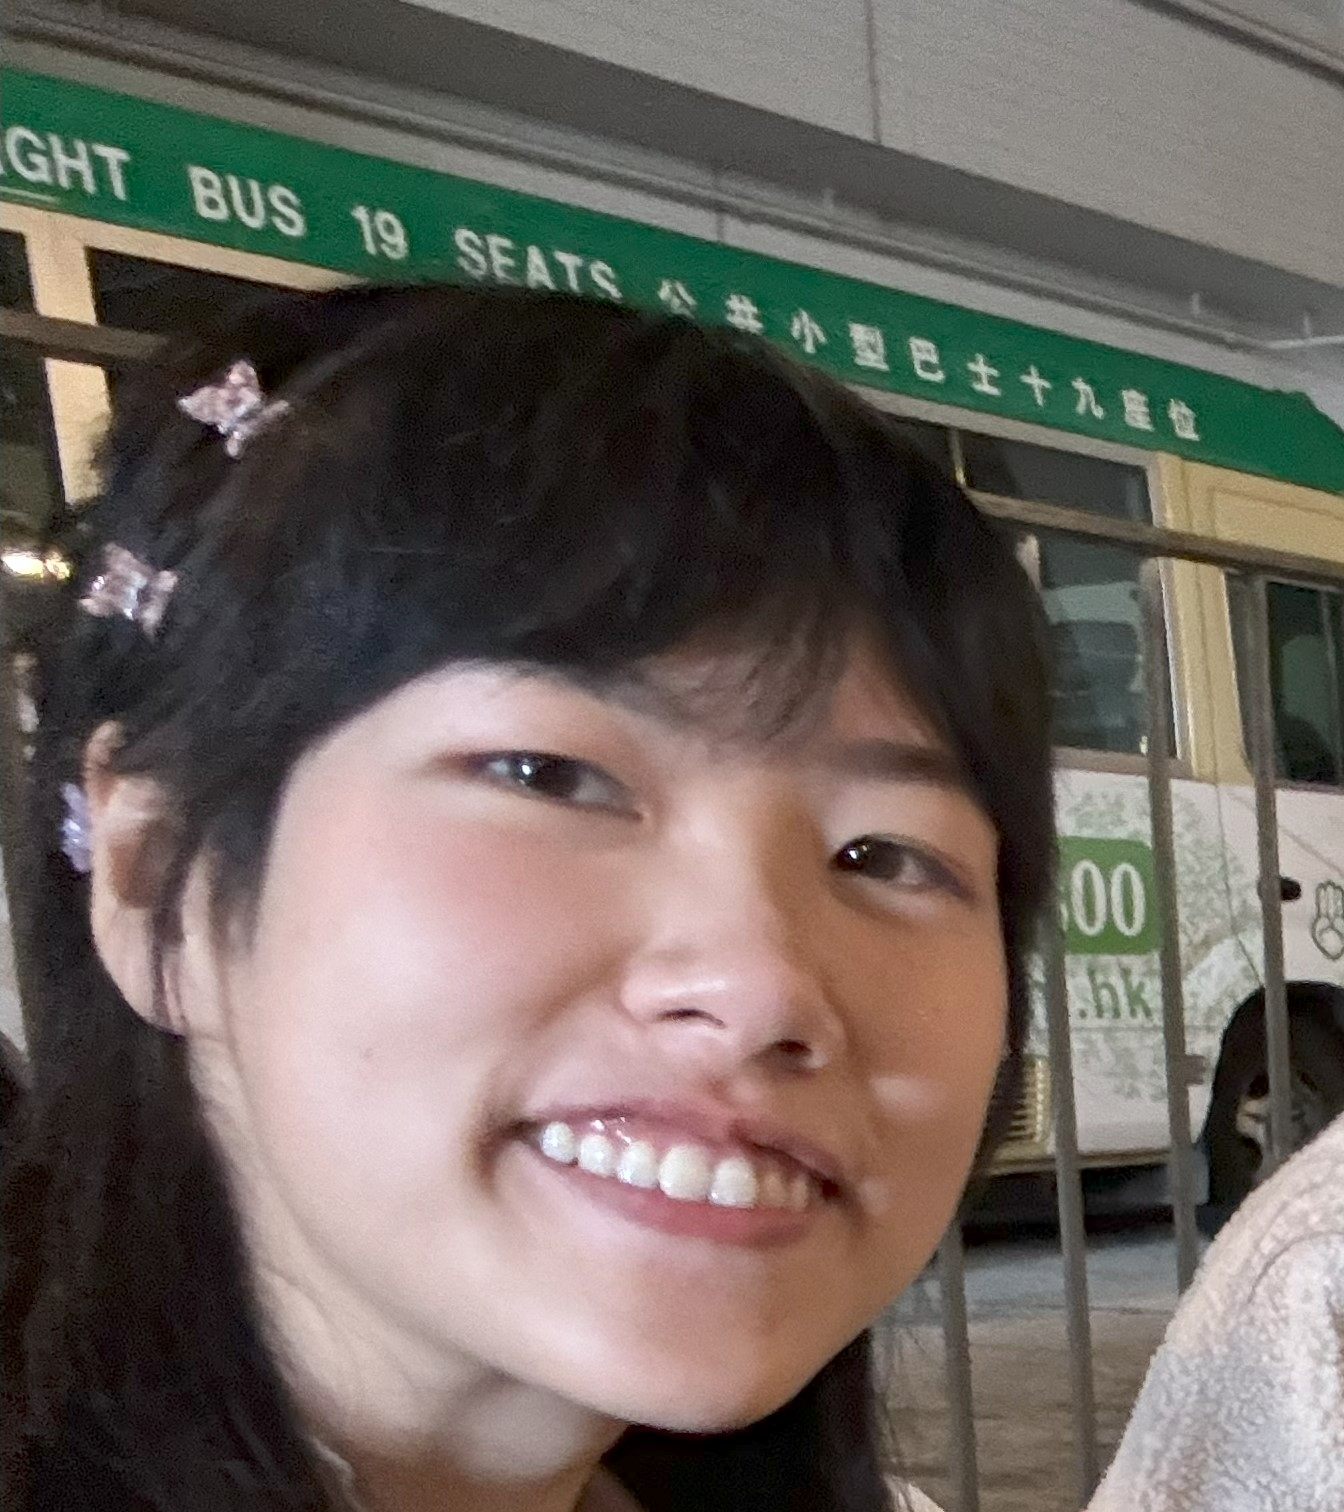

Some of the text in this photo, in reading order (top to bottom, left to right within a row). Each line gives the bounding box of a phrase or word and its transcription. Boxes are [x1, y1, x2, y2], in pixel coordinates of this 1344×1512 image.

[0, 126, 624, 300] GHT BUS 19 SEATS
[1059, 859, 1146, 936] 00
